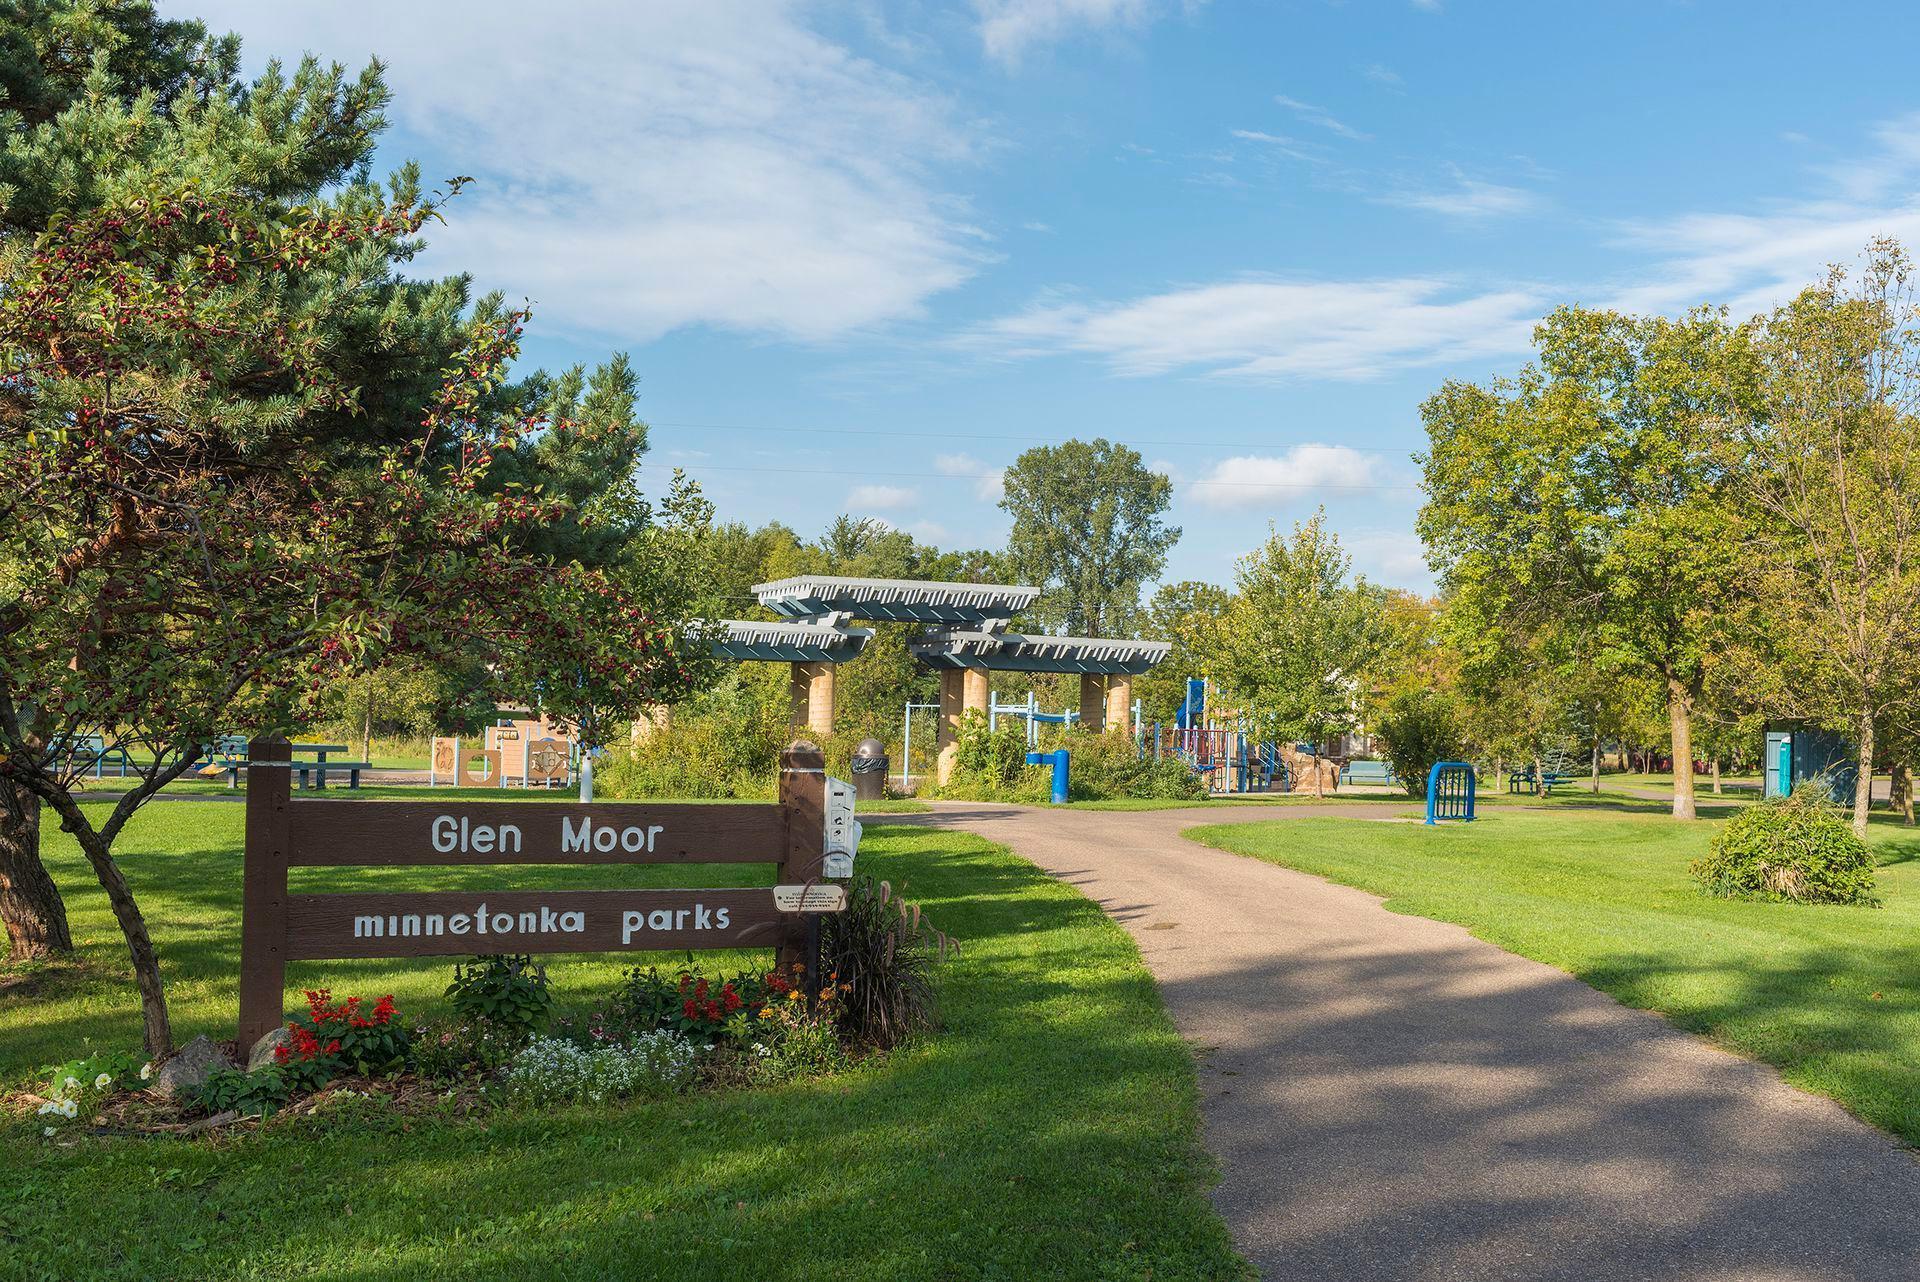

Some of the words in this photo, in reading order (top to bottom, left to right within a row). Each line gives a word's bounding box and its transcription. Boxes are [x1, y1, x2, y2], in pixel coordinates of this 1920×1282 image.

[431, 815, 522, 853] Glen
[561, 816, 664, 853] Moor
[353, 902, 585, 938] minnetonka
[622, 903, 730, 945] parks
